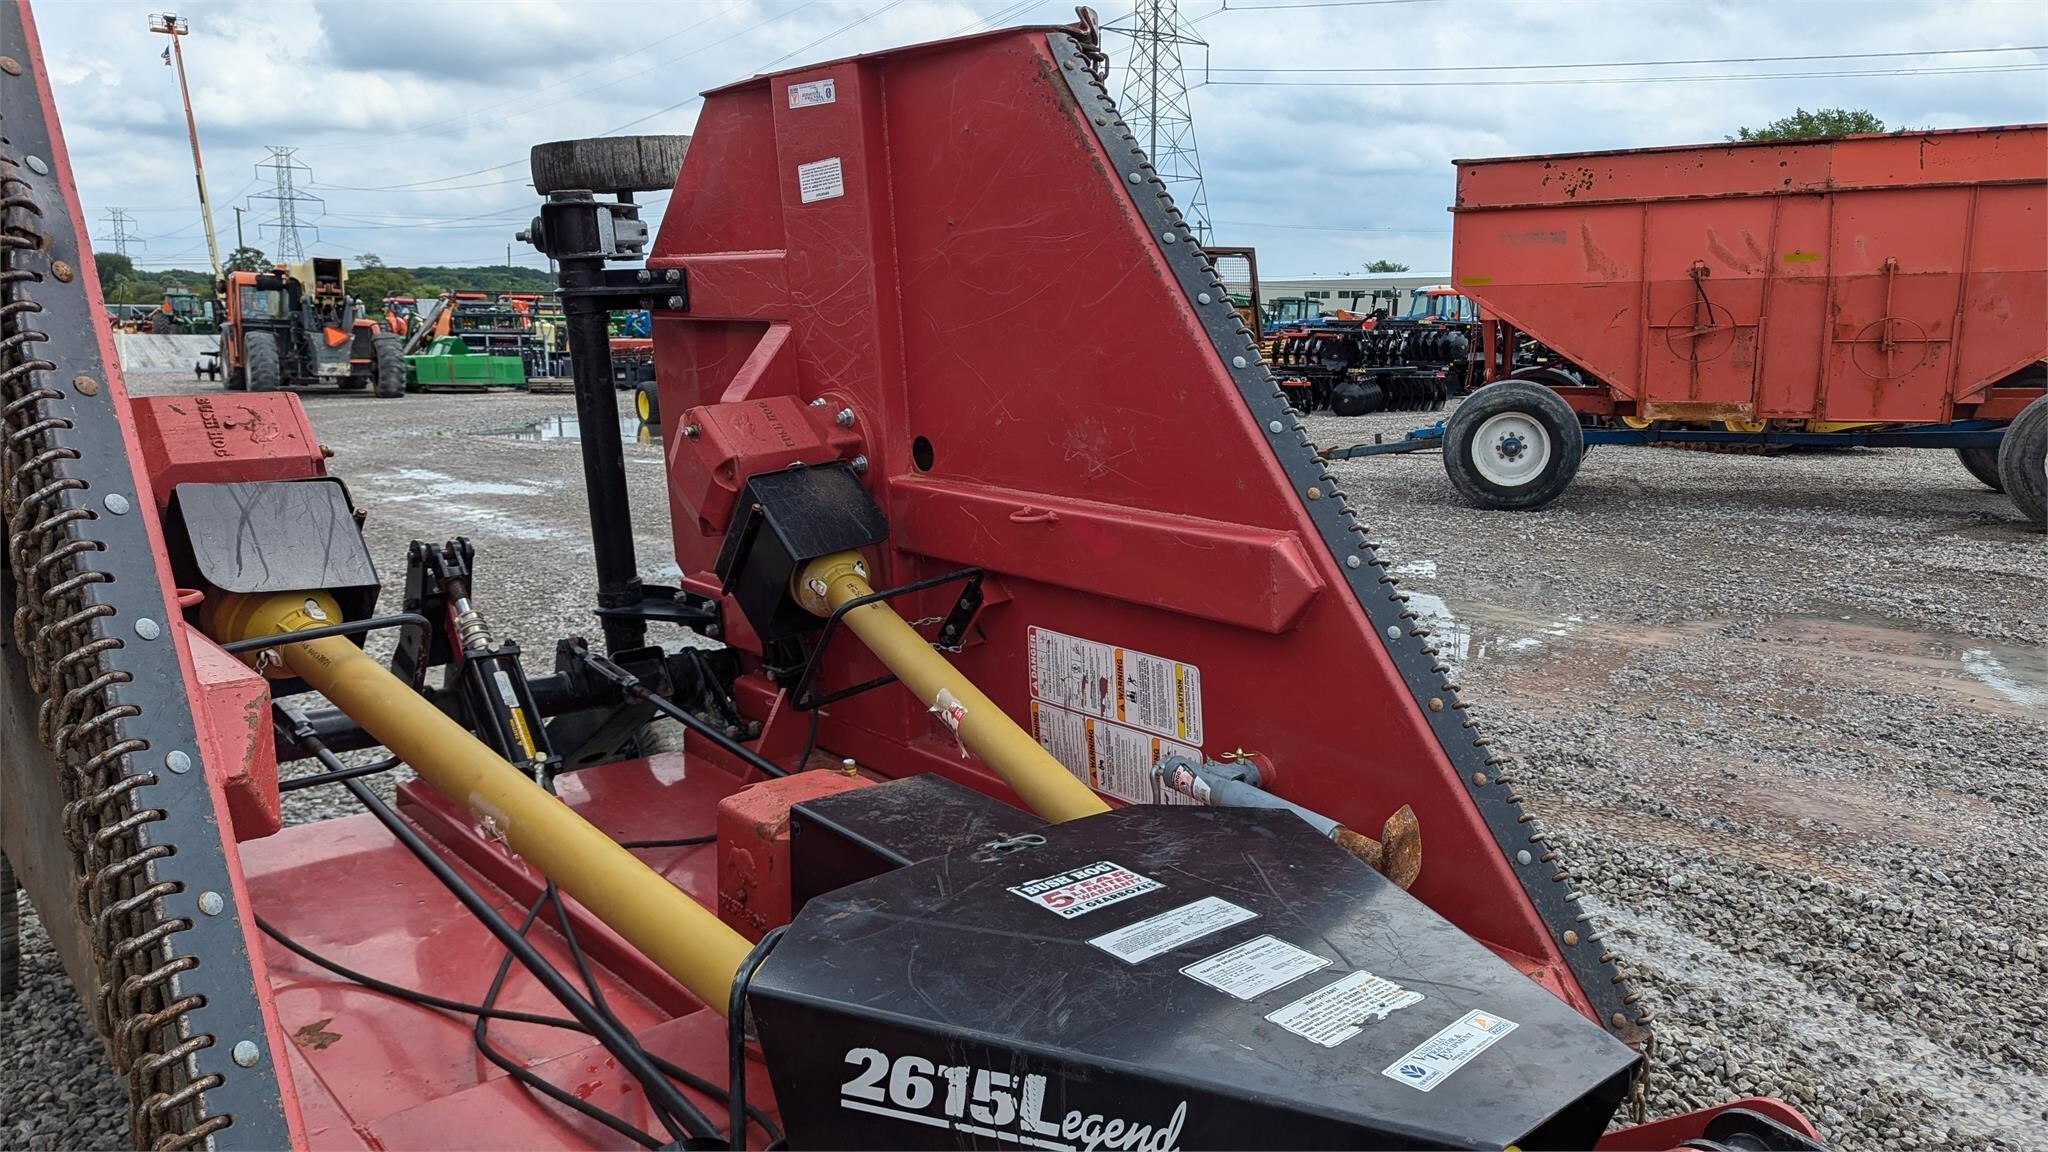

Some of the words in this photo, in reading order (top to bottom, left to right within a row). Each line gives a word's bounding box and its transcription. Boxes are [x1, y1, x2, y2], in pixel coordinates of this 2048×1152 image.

[194, 397, 220, 429] BUSH
[207, 431, 232, 457] HOG
[1116, 658, 1125, 700] WARNING
[1177, 679, 1185, 713] CAUTION
[1087, 729, 1097, 768] WARNING
[1021, 875, 1071, 895] BUSH
[1073, 862, 1113, 881] HOG
[1041, 890, 1075, 908] 5
[1063, 870, 1128, 891] YEAR
[1071, 874, 1137, 898] LIMITED
[1076, 877, 1144, 901] WARRANTY
[1062, 905, 1085, 916] ON
[1085, 882, 1158, 909] GEARBOXES
[1304, 987, 1339, 1004] IMPORTANT
[1411, 1037, 1448, 1060] VANDALIA
[1422, 1037, 1457, 1060] TRACTOR
[1436, 1032, 1475, 1061] EQUIPMENT
